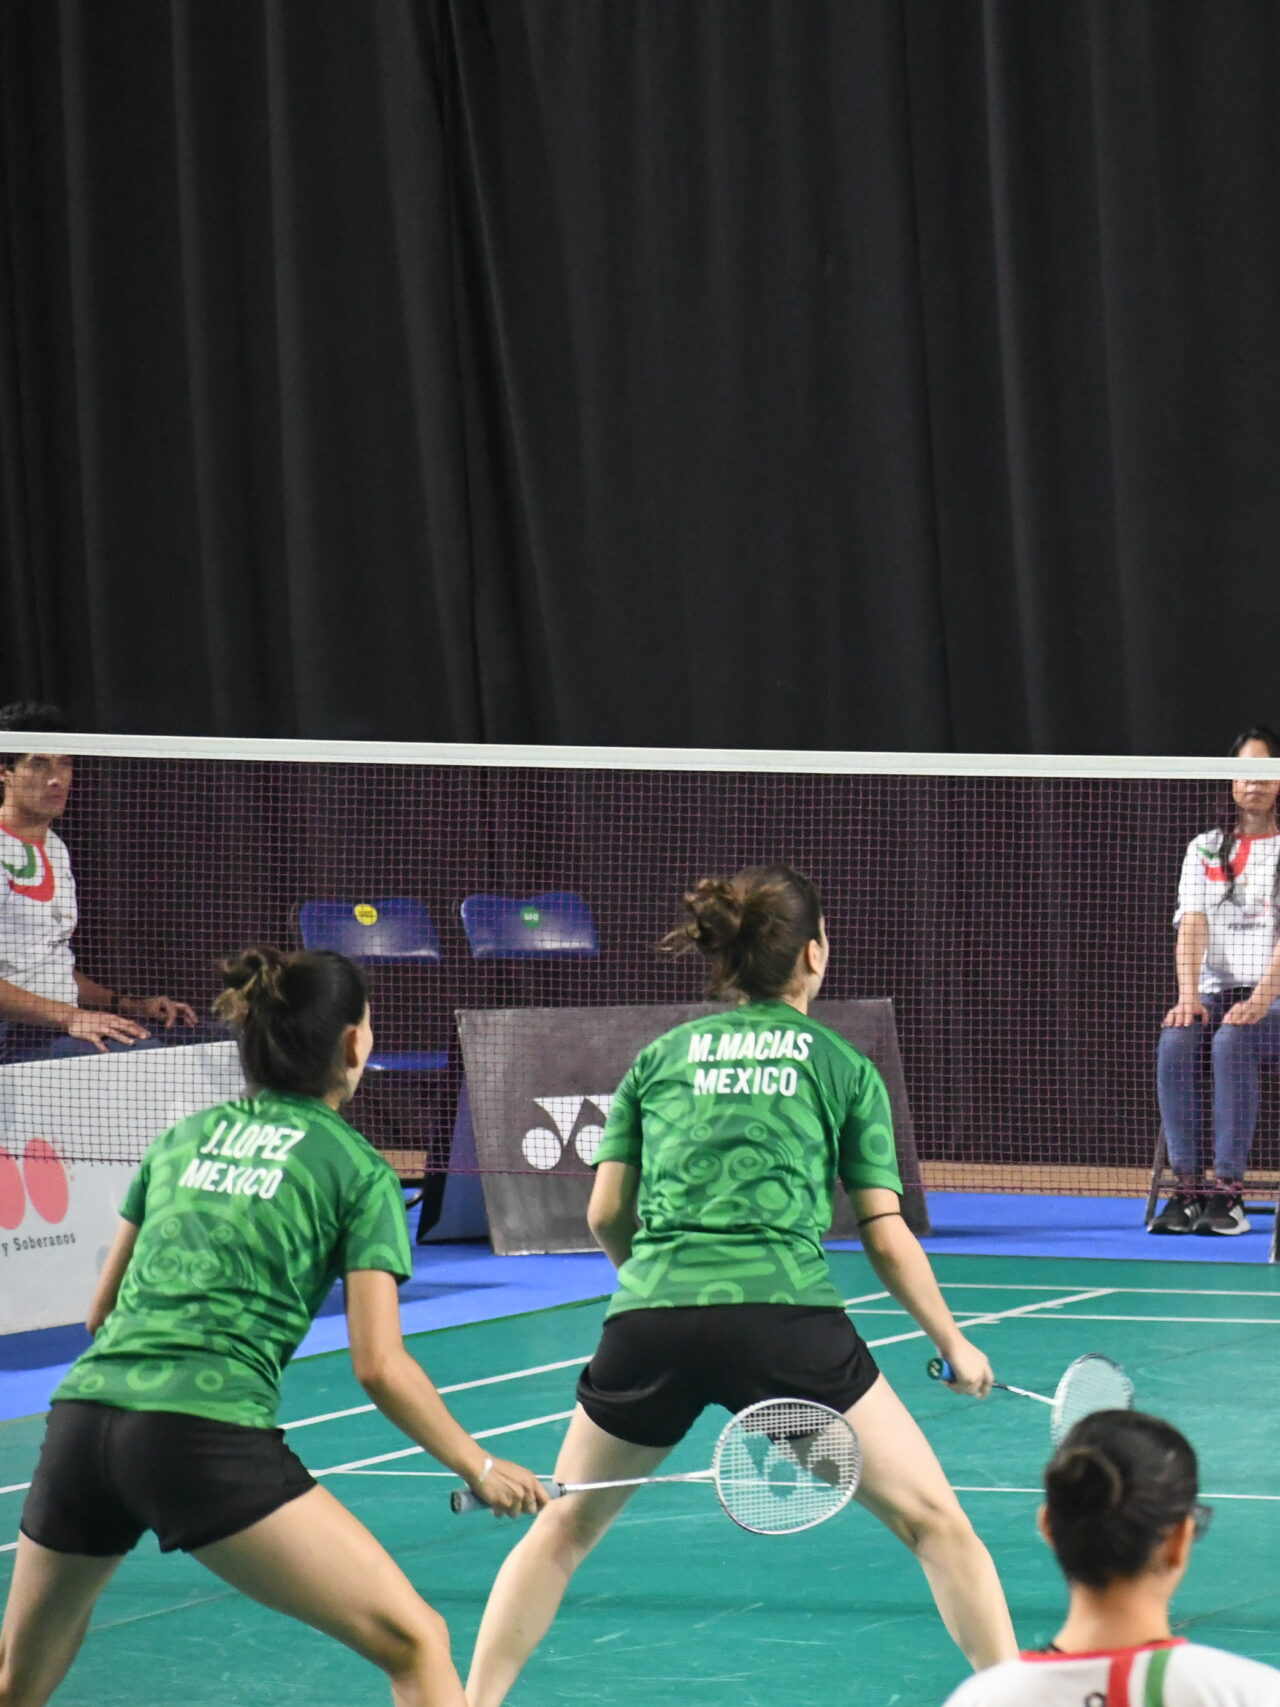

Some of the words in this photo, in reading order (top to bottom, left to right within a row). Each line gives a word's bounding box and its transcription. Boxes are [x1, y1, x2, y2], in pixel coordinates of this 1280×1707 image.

[687, 1030, 813, 1063] M.MACIAS
[694, 1066, 798, 1097] MEXICO
[200, 1120, 305, 1162] J.LOPEZ
[178, 1158, 283, 1199] MEXICO
[1, 1242, 9, 1257] y
[13, 1232, 76, 1251] Soberanos
